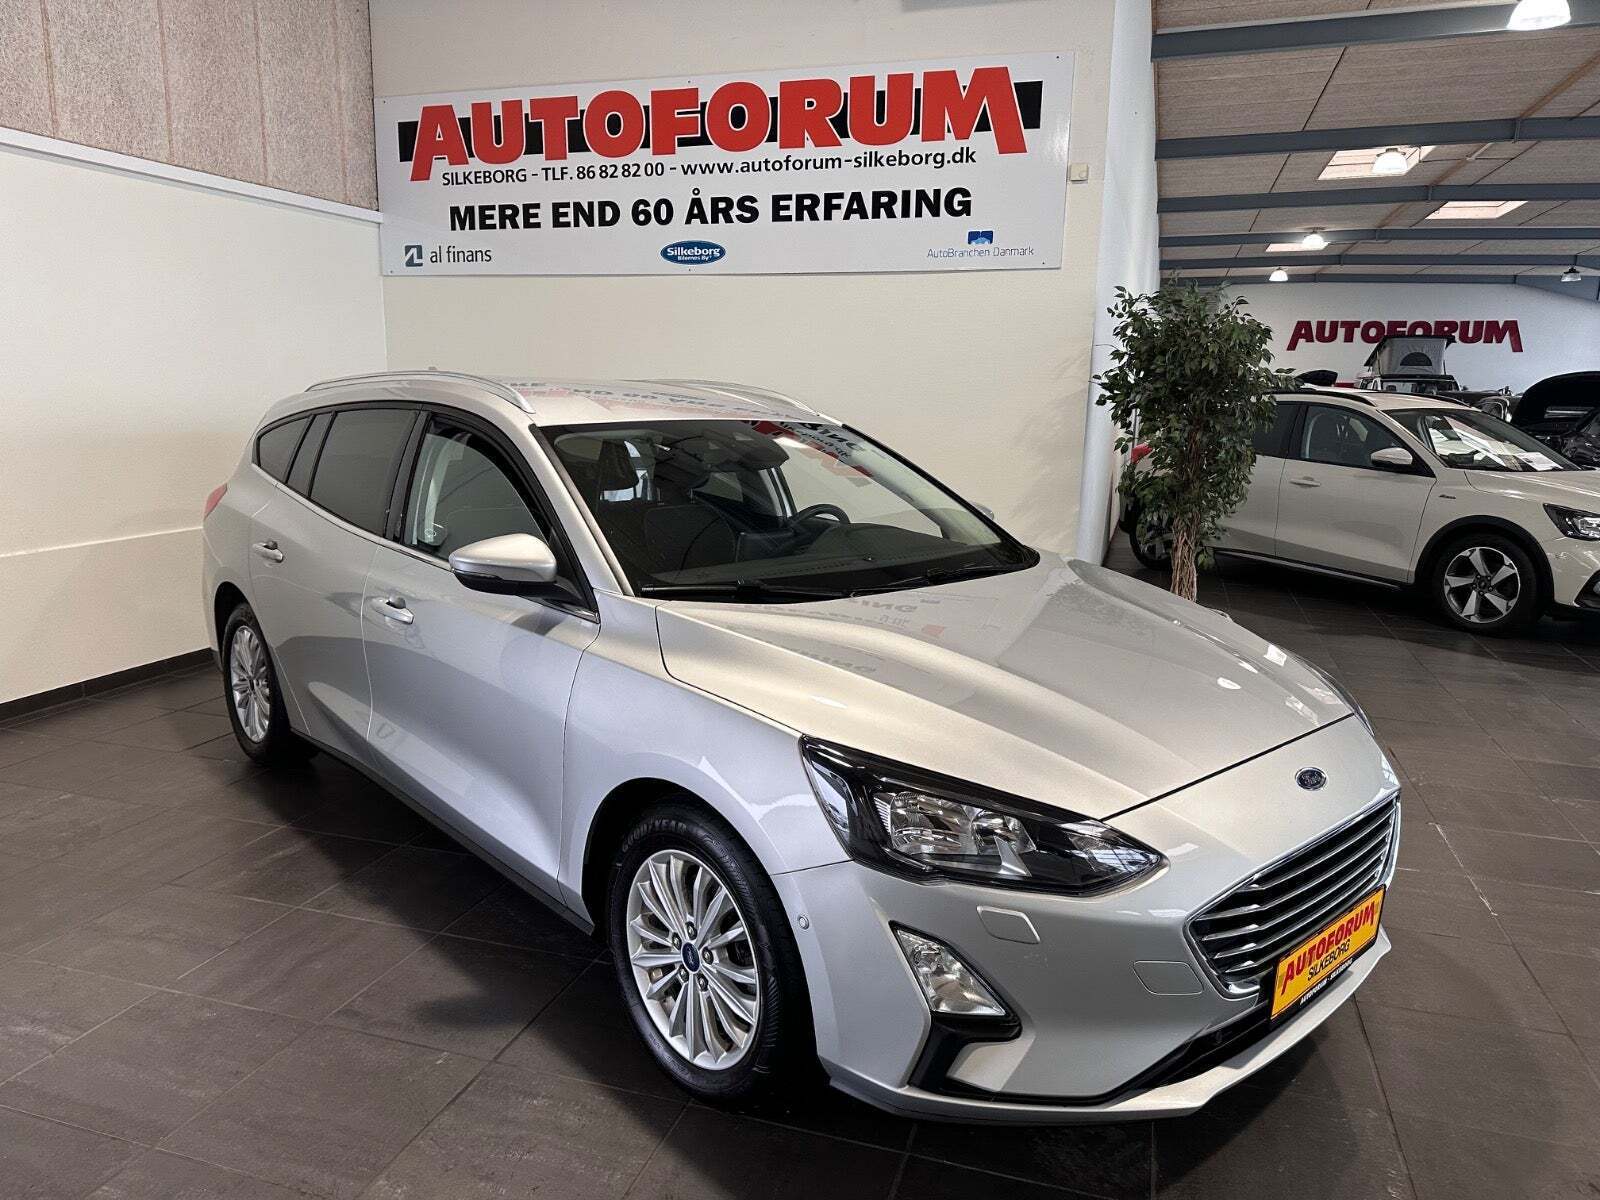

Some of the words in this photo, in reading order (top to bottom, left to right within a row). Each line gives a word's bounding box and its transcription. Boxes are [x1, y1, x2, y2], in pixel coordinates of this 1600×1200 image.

[410, 66, 1027, 182] AUTOFORUM
[442, 168, 527, 186] SILKEBORG
[541, 166, 574, 182] TLF.
[680, 147, 977, 176] www.autoforum-silkeborg.dk
[449, 202, 542, 232] MERE
[551, 200, 621, 229] END
[631, 197, 674, 227] 60
[684, 187, 760, 225] ÅRS
[771, 187, 972, 223] ERFARING
[429, 245, 442, 264] al
[446, 245, 492, 263] finans
[666, 246, 721, 257] Silkeborg
[926, 247, 991, 259] AutoBranchen
[993, 246, 1035, 257] Danmark
[1286, 319, 1524, 353] AUTOFORUM
[1280, 900, 1376, 996] AUTOFORUM
[1307, 939, 1351, 981] SILKEBORG
